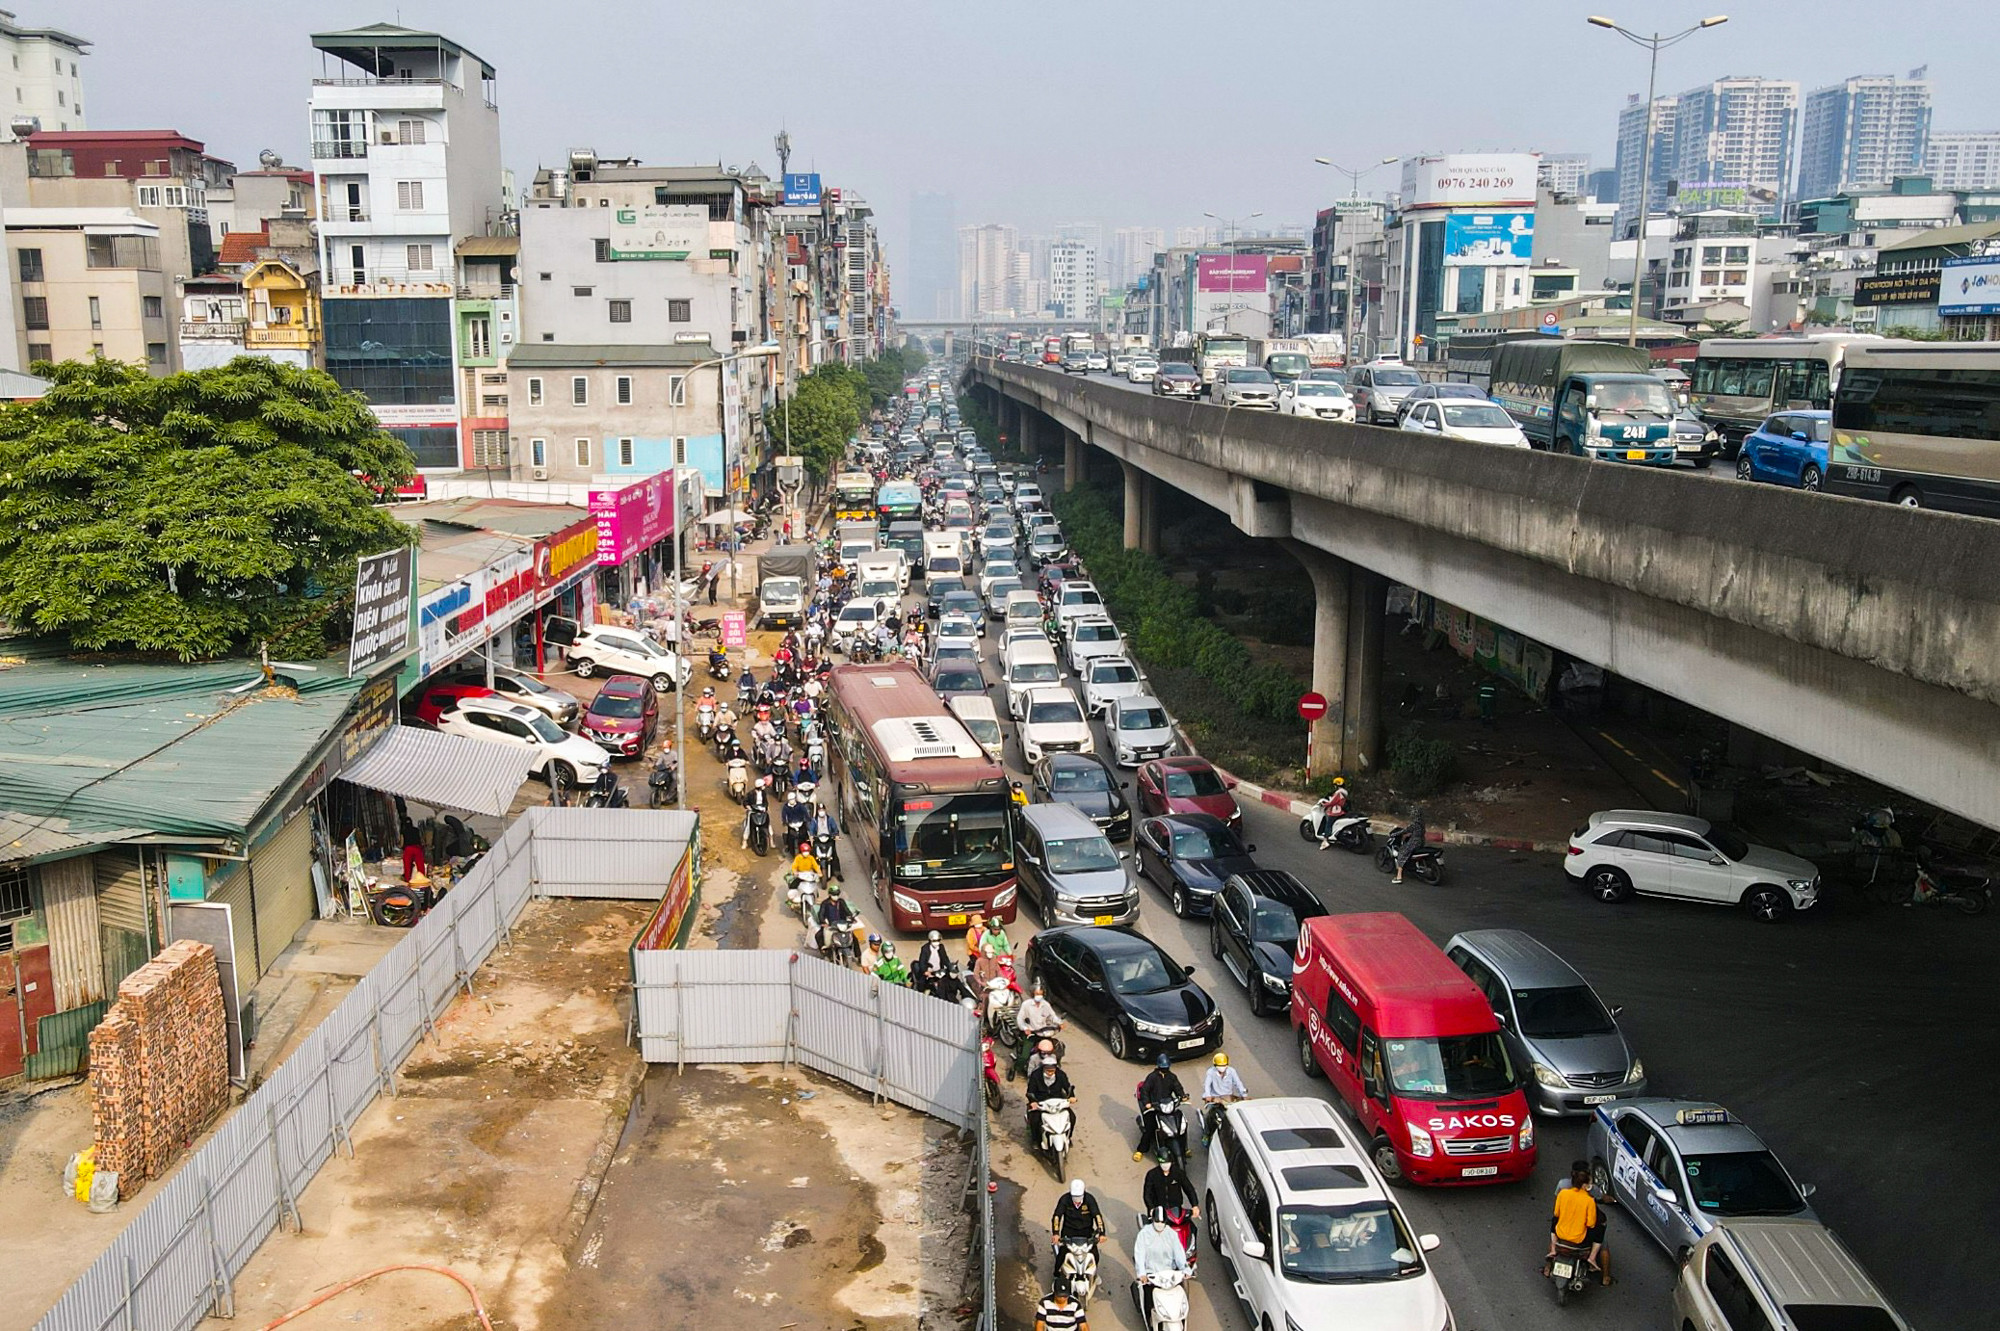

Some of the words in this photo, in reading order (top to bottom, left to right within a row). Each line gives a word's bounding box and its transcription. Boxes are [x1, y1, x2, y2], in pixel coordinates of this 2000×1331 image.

[1438, 178, 1465, 189] 0976
[1469, 178, 1489, 188] 240
[1493, 177, 1513, 188] 269
[1623, 426, 1646, 439] 24H
[598, 510, 617, 518] HĂN
[359, 580, 382, 605] KHÓA
[357, 606, 379, 634] ĐIỆN
[354, 631, 379, 660] NƯỚC
[1428, 1114, 1516, 1131] SAKOS
